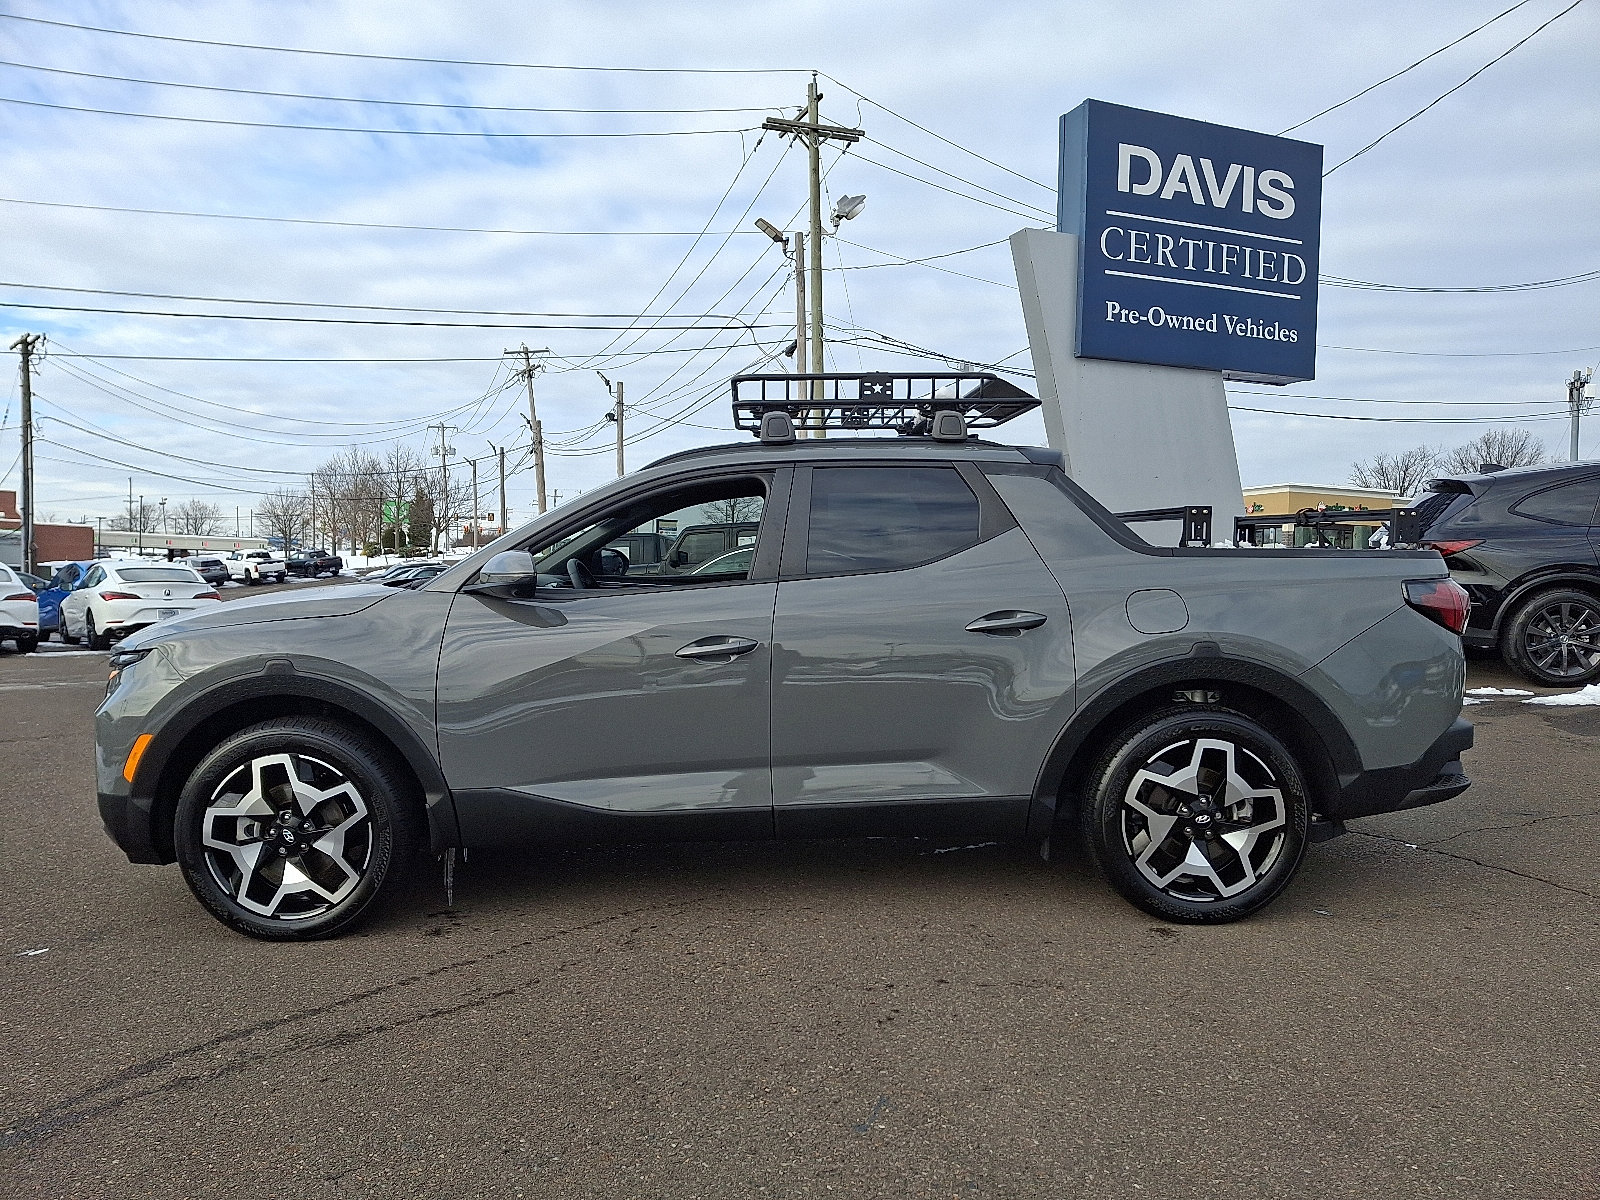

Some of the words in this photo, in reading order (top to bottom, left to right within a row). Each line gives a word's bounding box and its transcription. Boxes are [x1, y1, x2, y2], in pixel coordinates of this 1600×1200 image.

[1117, 143, 1296, 220] DAVIS
[1100, 226, 1307, 285] CERTIFIED
[1105, 300, 1218, 333] Pre-Owned
[1222, 314, 1298, 343] Vehicles
